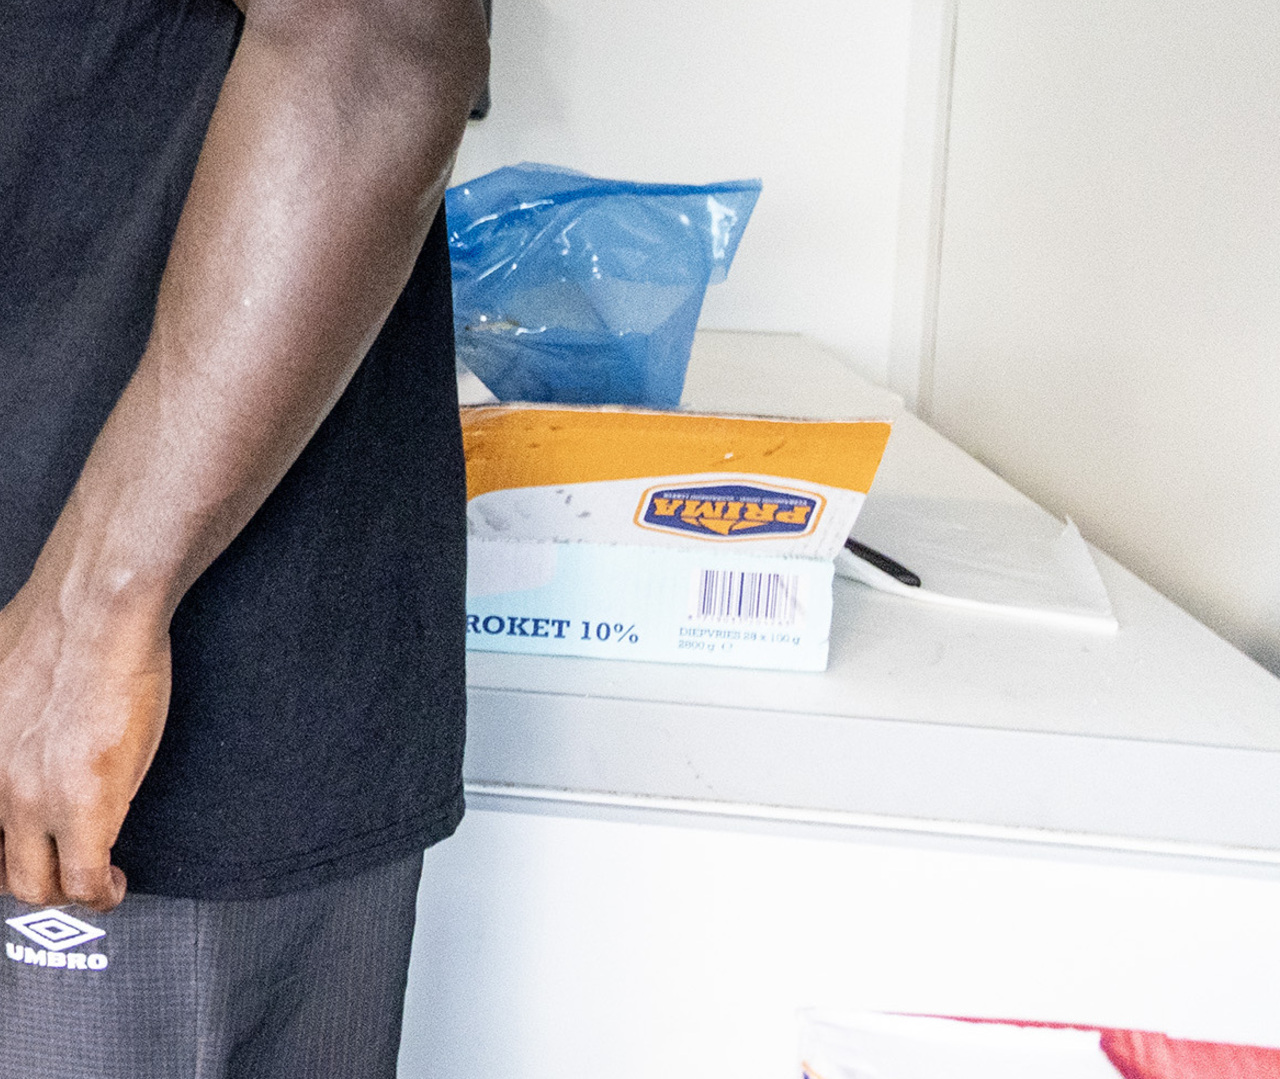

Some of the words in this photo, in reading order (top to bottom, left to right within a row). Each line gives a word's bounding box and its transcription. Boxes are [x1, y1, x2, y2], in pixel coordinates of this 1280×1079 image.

[653, 498, 811, 524] PRIMA
[581, 621, 639, 644] 10%
[679, 627, 741, 639] DIEPVRIES
[5, 942, 109, 970] UMBRO
